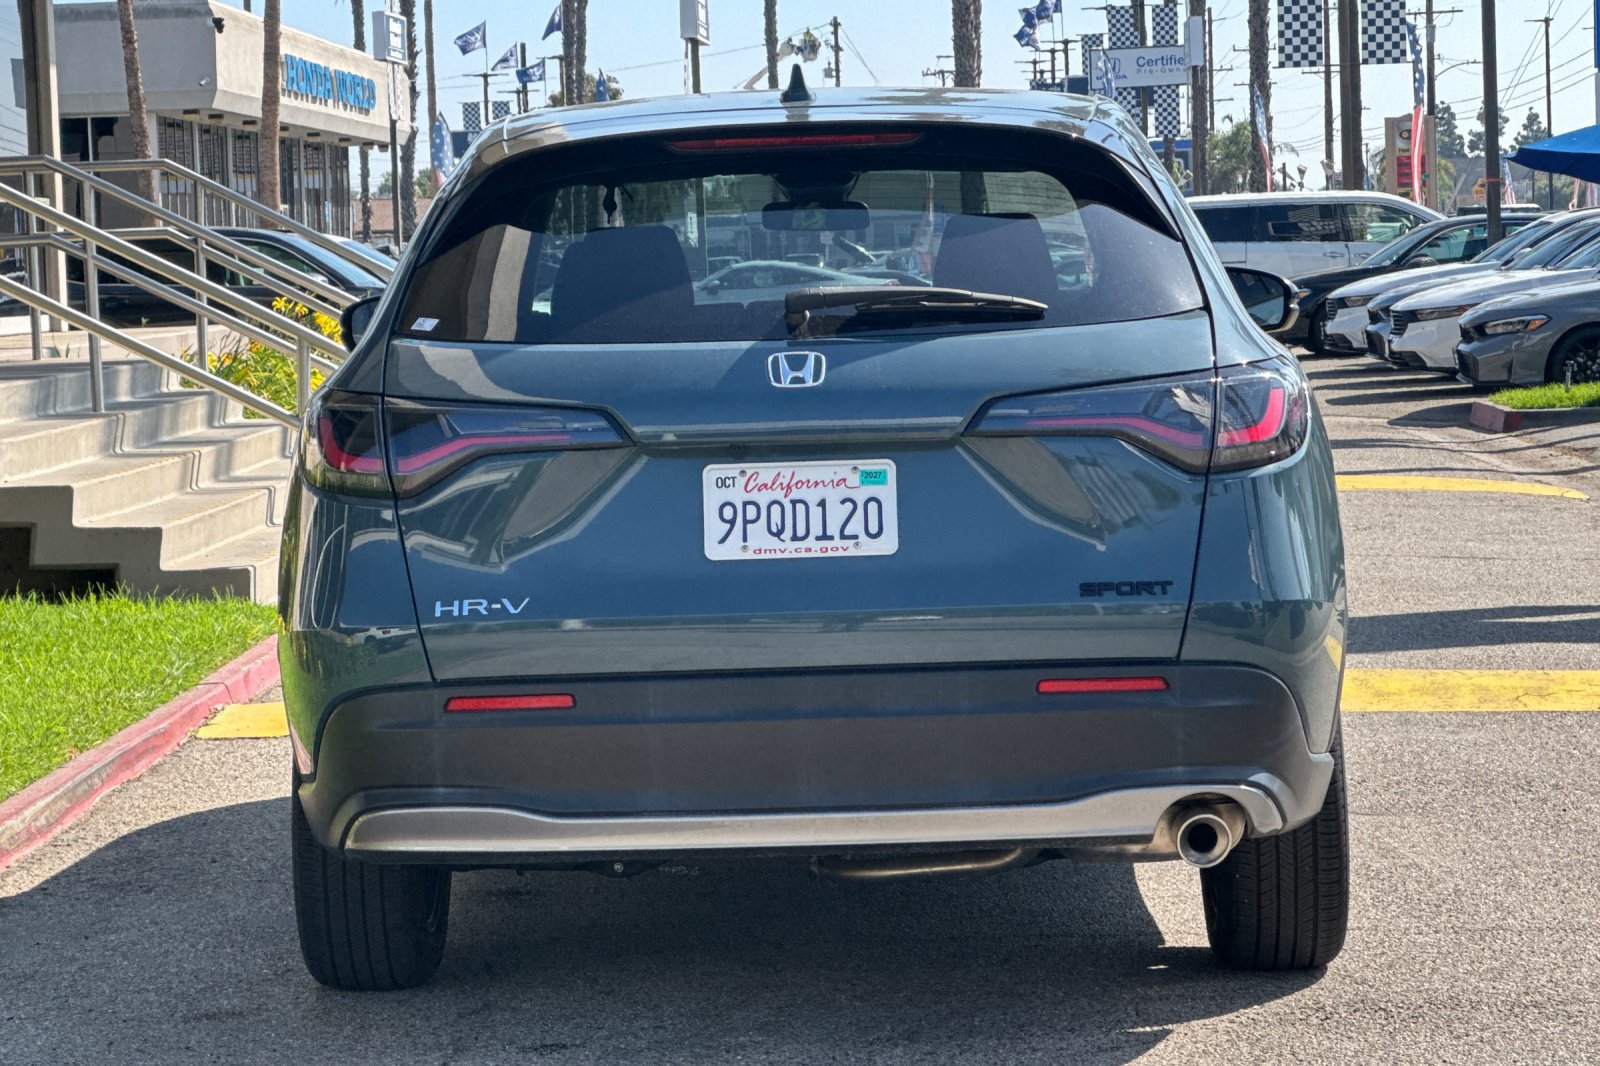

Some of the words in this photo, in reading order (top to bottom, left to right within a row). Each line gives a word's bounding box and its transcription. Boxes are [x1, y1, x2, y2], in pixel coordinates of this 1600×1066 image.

[1136, 54, 1185, 68] Certifie
[1137, 67, 1187, 75] Pre-Own
[285, 53, 334, 99] HONDA
[334, 69, 377, 110] WORLD
[715, 476, 737, 489] OCT
[743, 470, 861, 498] California
[863, 471, 882, 479] 2027
[717, 496, 884, 545] 9PQD120
[753, 545, 850, 555] dmv.ca.gov
[1079, 580, 1174, 597] SPORT
[434, 597, 531, 617] HR-V
